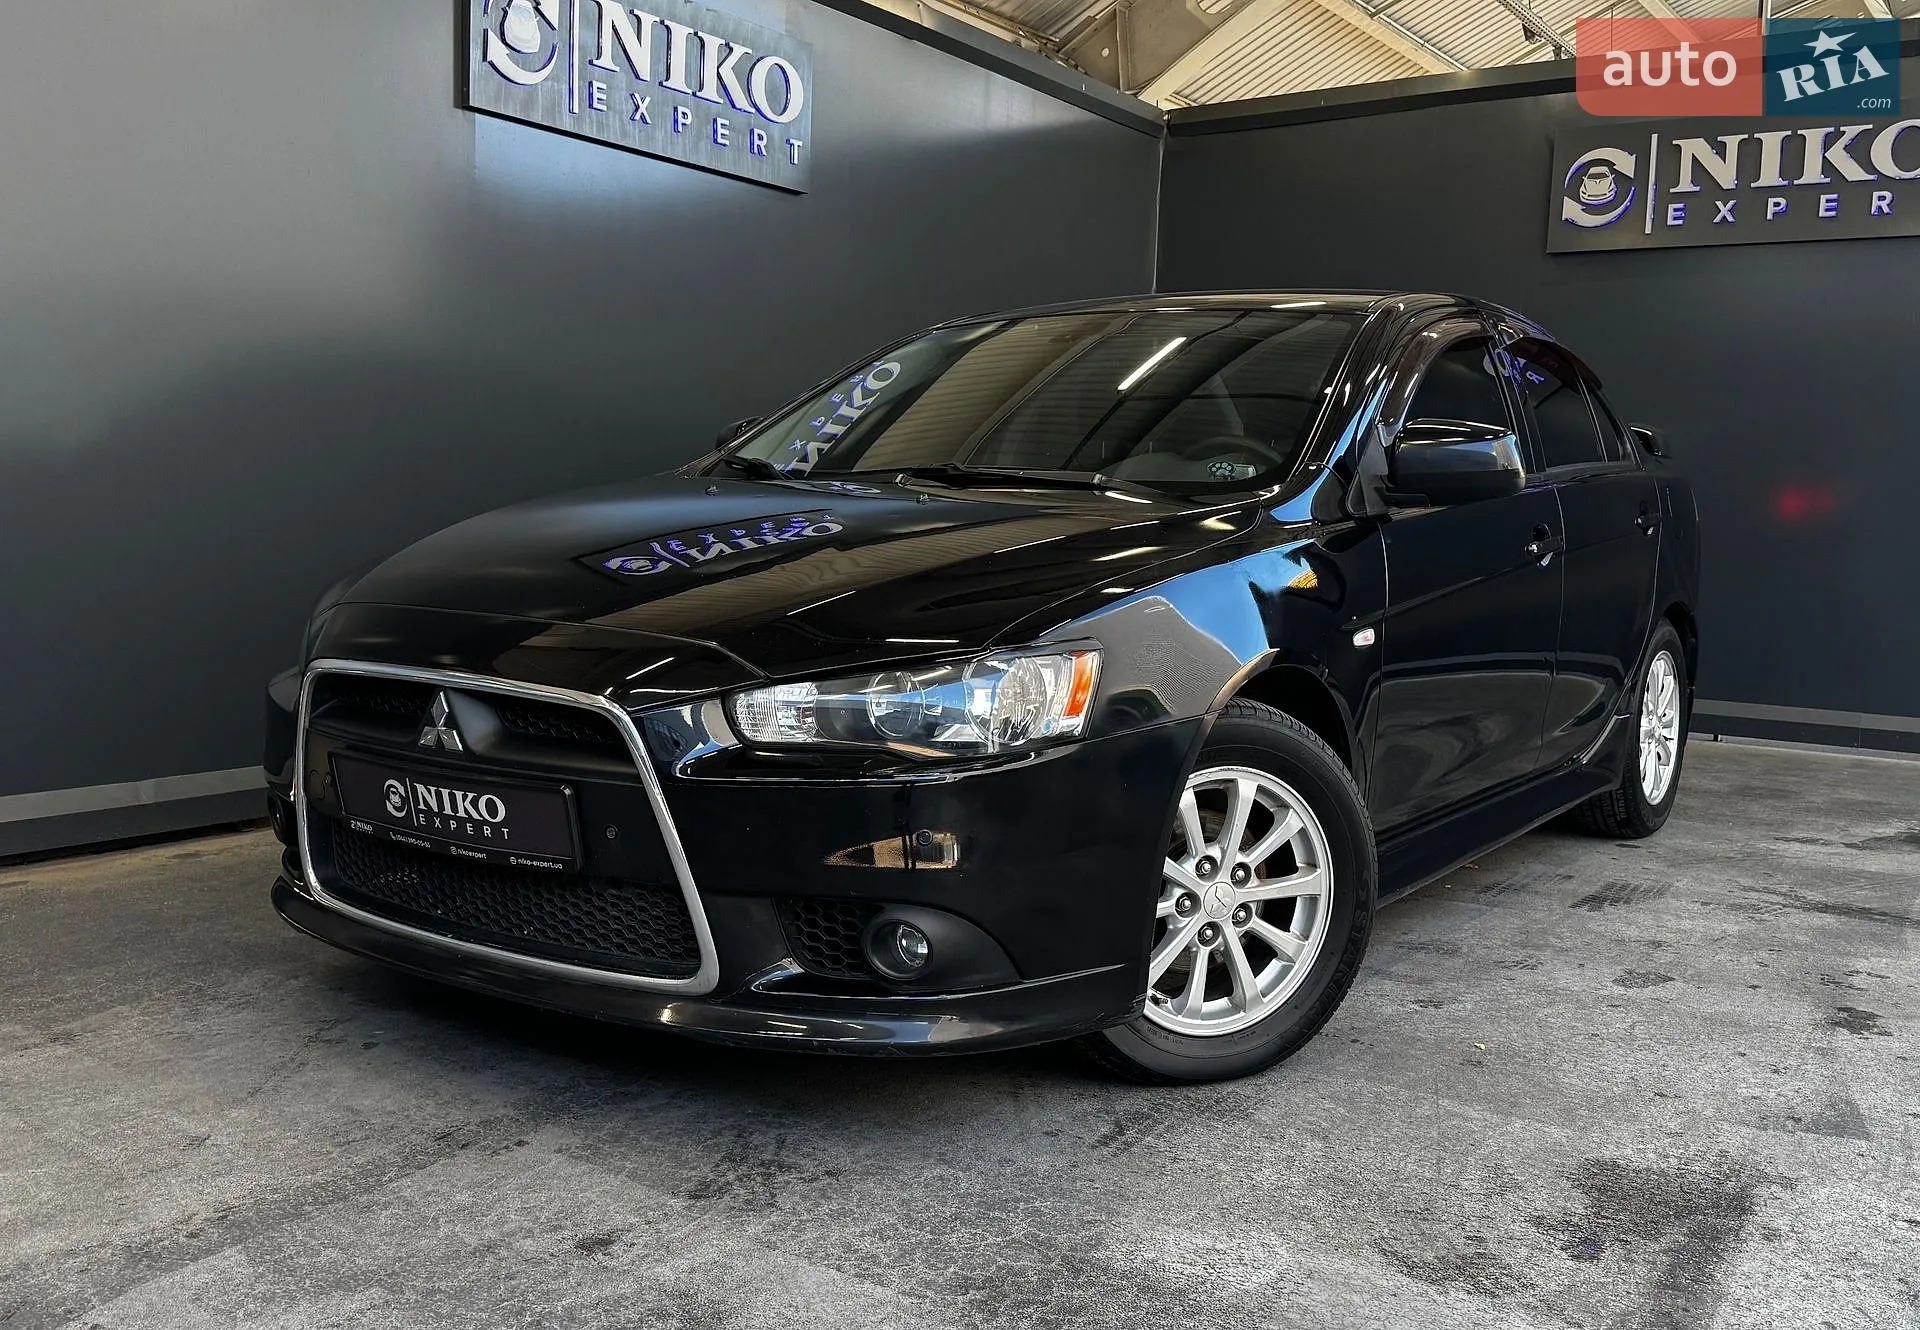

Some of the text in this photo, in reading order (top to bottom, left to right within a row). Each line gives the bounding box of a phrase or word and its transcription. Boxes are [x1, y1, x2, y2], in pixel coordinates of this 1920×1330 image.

[588, 0, 804, 124] NIKO
[588, 80, 803, 165] EXPERT
[413, 782, 506, 823] NIKO
[419, 813, 510, 840] EXPERT
